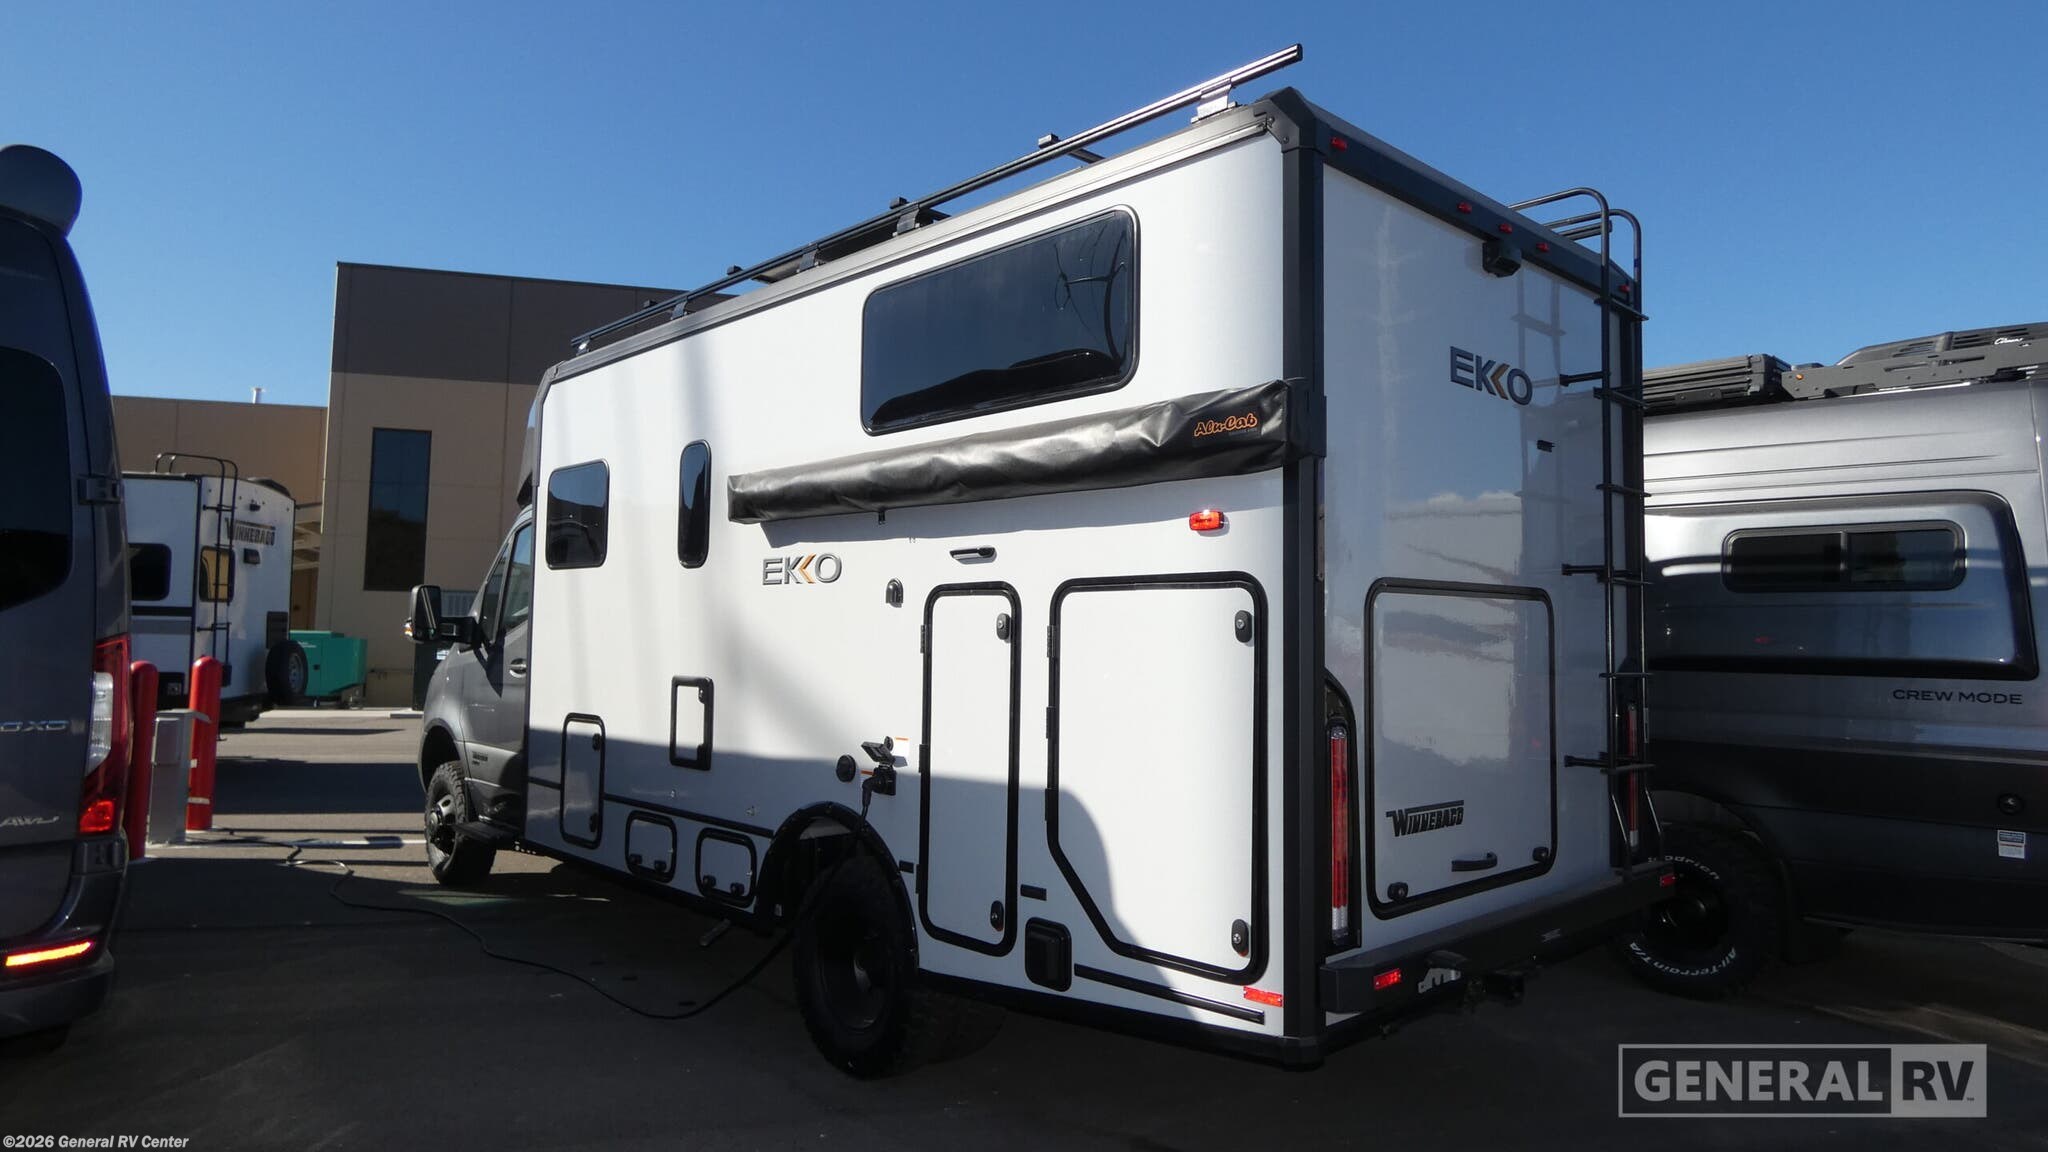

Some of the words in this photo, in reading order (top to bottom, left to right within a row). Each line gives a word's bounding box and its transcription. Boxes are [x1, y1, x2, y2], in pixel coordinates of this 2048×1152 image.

[1450, 345, 1533, 405] EKKO
[1194, 413, 1257, 437] Alu-Cab
[762, 553, 842, 584] EKKO
[1892, 689, 1953, 702] CREW
[1959, 692, 2022, 705] MODE
[1385, 800, 1464, 837] WINNEBAGO
